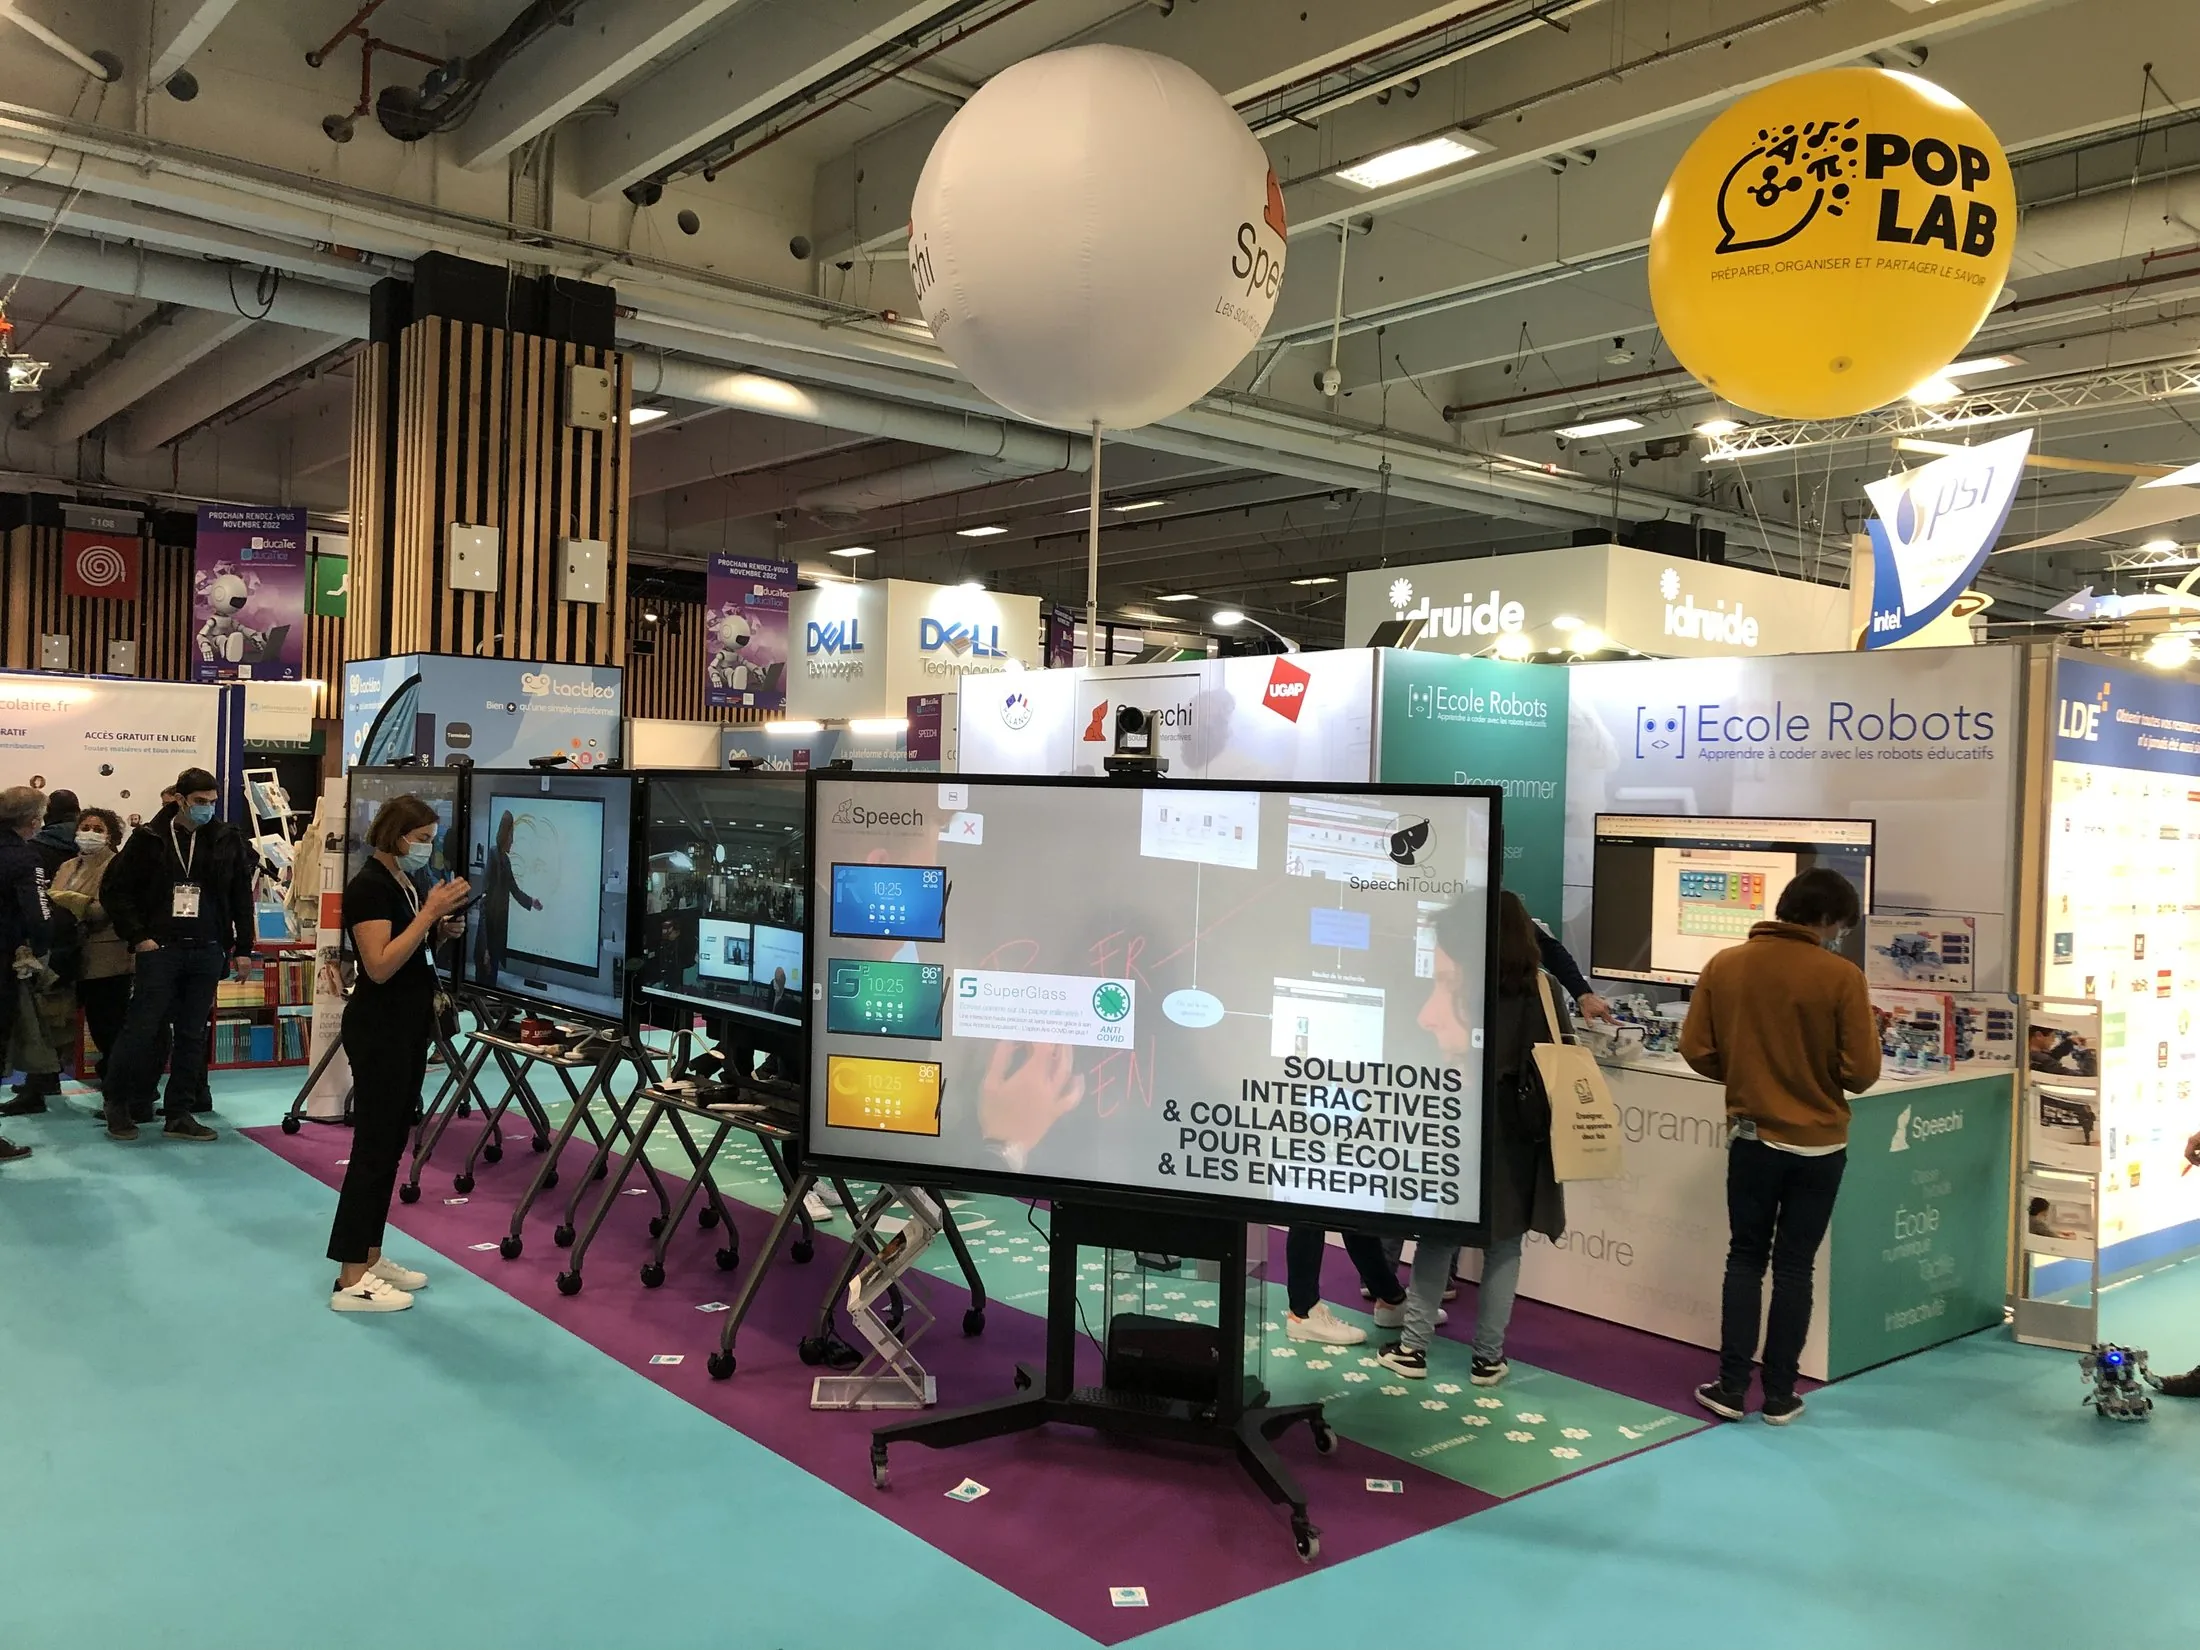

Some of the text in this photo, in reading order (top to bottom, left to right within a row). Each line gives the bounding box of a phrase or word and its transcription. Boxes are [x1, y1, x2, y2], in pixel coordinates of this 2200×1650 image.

[1865, 133, 1991, 193] POP
[1876, 189, 1998, 258] LAB
[1232, 222, 1284, 304] Spe
[1775, 257, 1850, 274] ORGANISER
[1855, 257, 1872, 269] ET
[1876, 259, 1938, 276] PARTAGER
[1940, 264, 1953, 279] LE
[1954, 268, 1987, 288] SAVOIR
[1215, 296, 1235, 317] Les
[209, 511, 295, 521] PROCHAIN RENDEZ-VOUS
[223, 520, 280, 529] NOVEMBRE 2022
[718, 559, 789, 574] PROCHAIN RENDEZ-VOUS
[730, 568, 777, 580] NOVEMBRE 2022
[1393, 588, 1525, 639] druide
[807, 618, 864, 656] DELL
[920, 617, 1008, 658] DELL
[807, 659, 863, 682] Technologies
[553, 678, 614, 699] tactileo
[1269, 682, 1305, 699] UGAP
[486, 700, 504, 711] Bien
[547, 704, 573, 716] simple
[1437, 686, 1548, 718] Ecole Robots
[1437, 712, 1466, 723] Apprendre
[1471, 715, 1487, 724] coder
[1508, 718, 1524, 726] robots
[1698, 698, 1995, 742] Ecole Robots
[2058, 698, 2101, 742] LDE
[85, 730, 197, 744] ACCÈS GRATUIT EN LIGNE
[1159, 732, 1192, 742] nteractives
[84, 744, 108, 753] Toutes
[109, 744, 142, 754] matières
[153, 746, 169, 754] tous
[841, 749, 848, 758] La
[848, 748, 883, 760] plateforme
[1698, 745, 1994, 762] Apprendre à coder avec les robots éducatifs
[873, 881, 902, 897] 10:25
[983, 982, 1067, 1001] SuperGlass
[1027, 1008, 1049, 1017] papier
[1096, 1033, 1125, 1043] COVID
[1100, 1025, 1122, 1034] ANTI
[1284, 1055, 1462, 1093] SOLUTIONS
[1242, 1078, 1462, 1121] INTERACTIVES
[1163, 1099, 1462, 1149] & COLLABORATIVES
[1912, 1109, 1964, 1142] Speechi
[1180, 1127, 1461, 1178] POUR LES ÉCOLES
[1158, 1152, 1460, 1206] & LES ENTREPRISES
[1894, 1203, 1940, 1240] École
